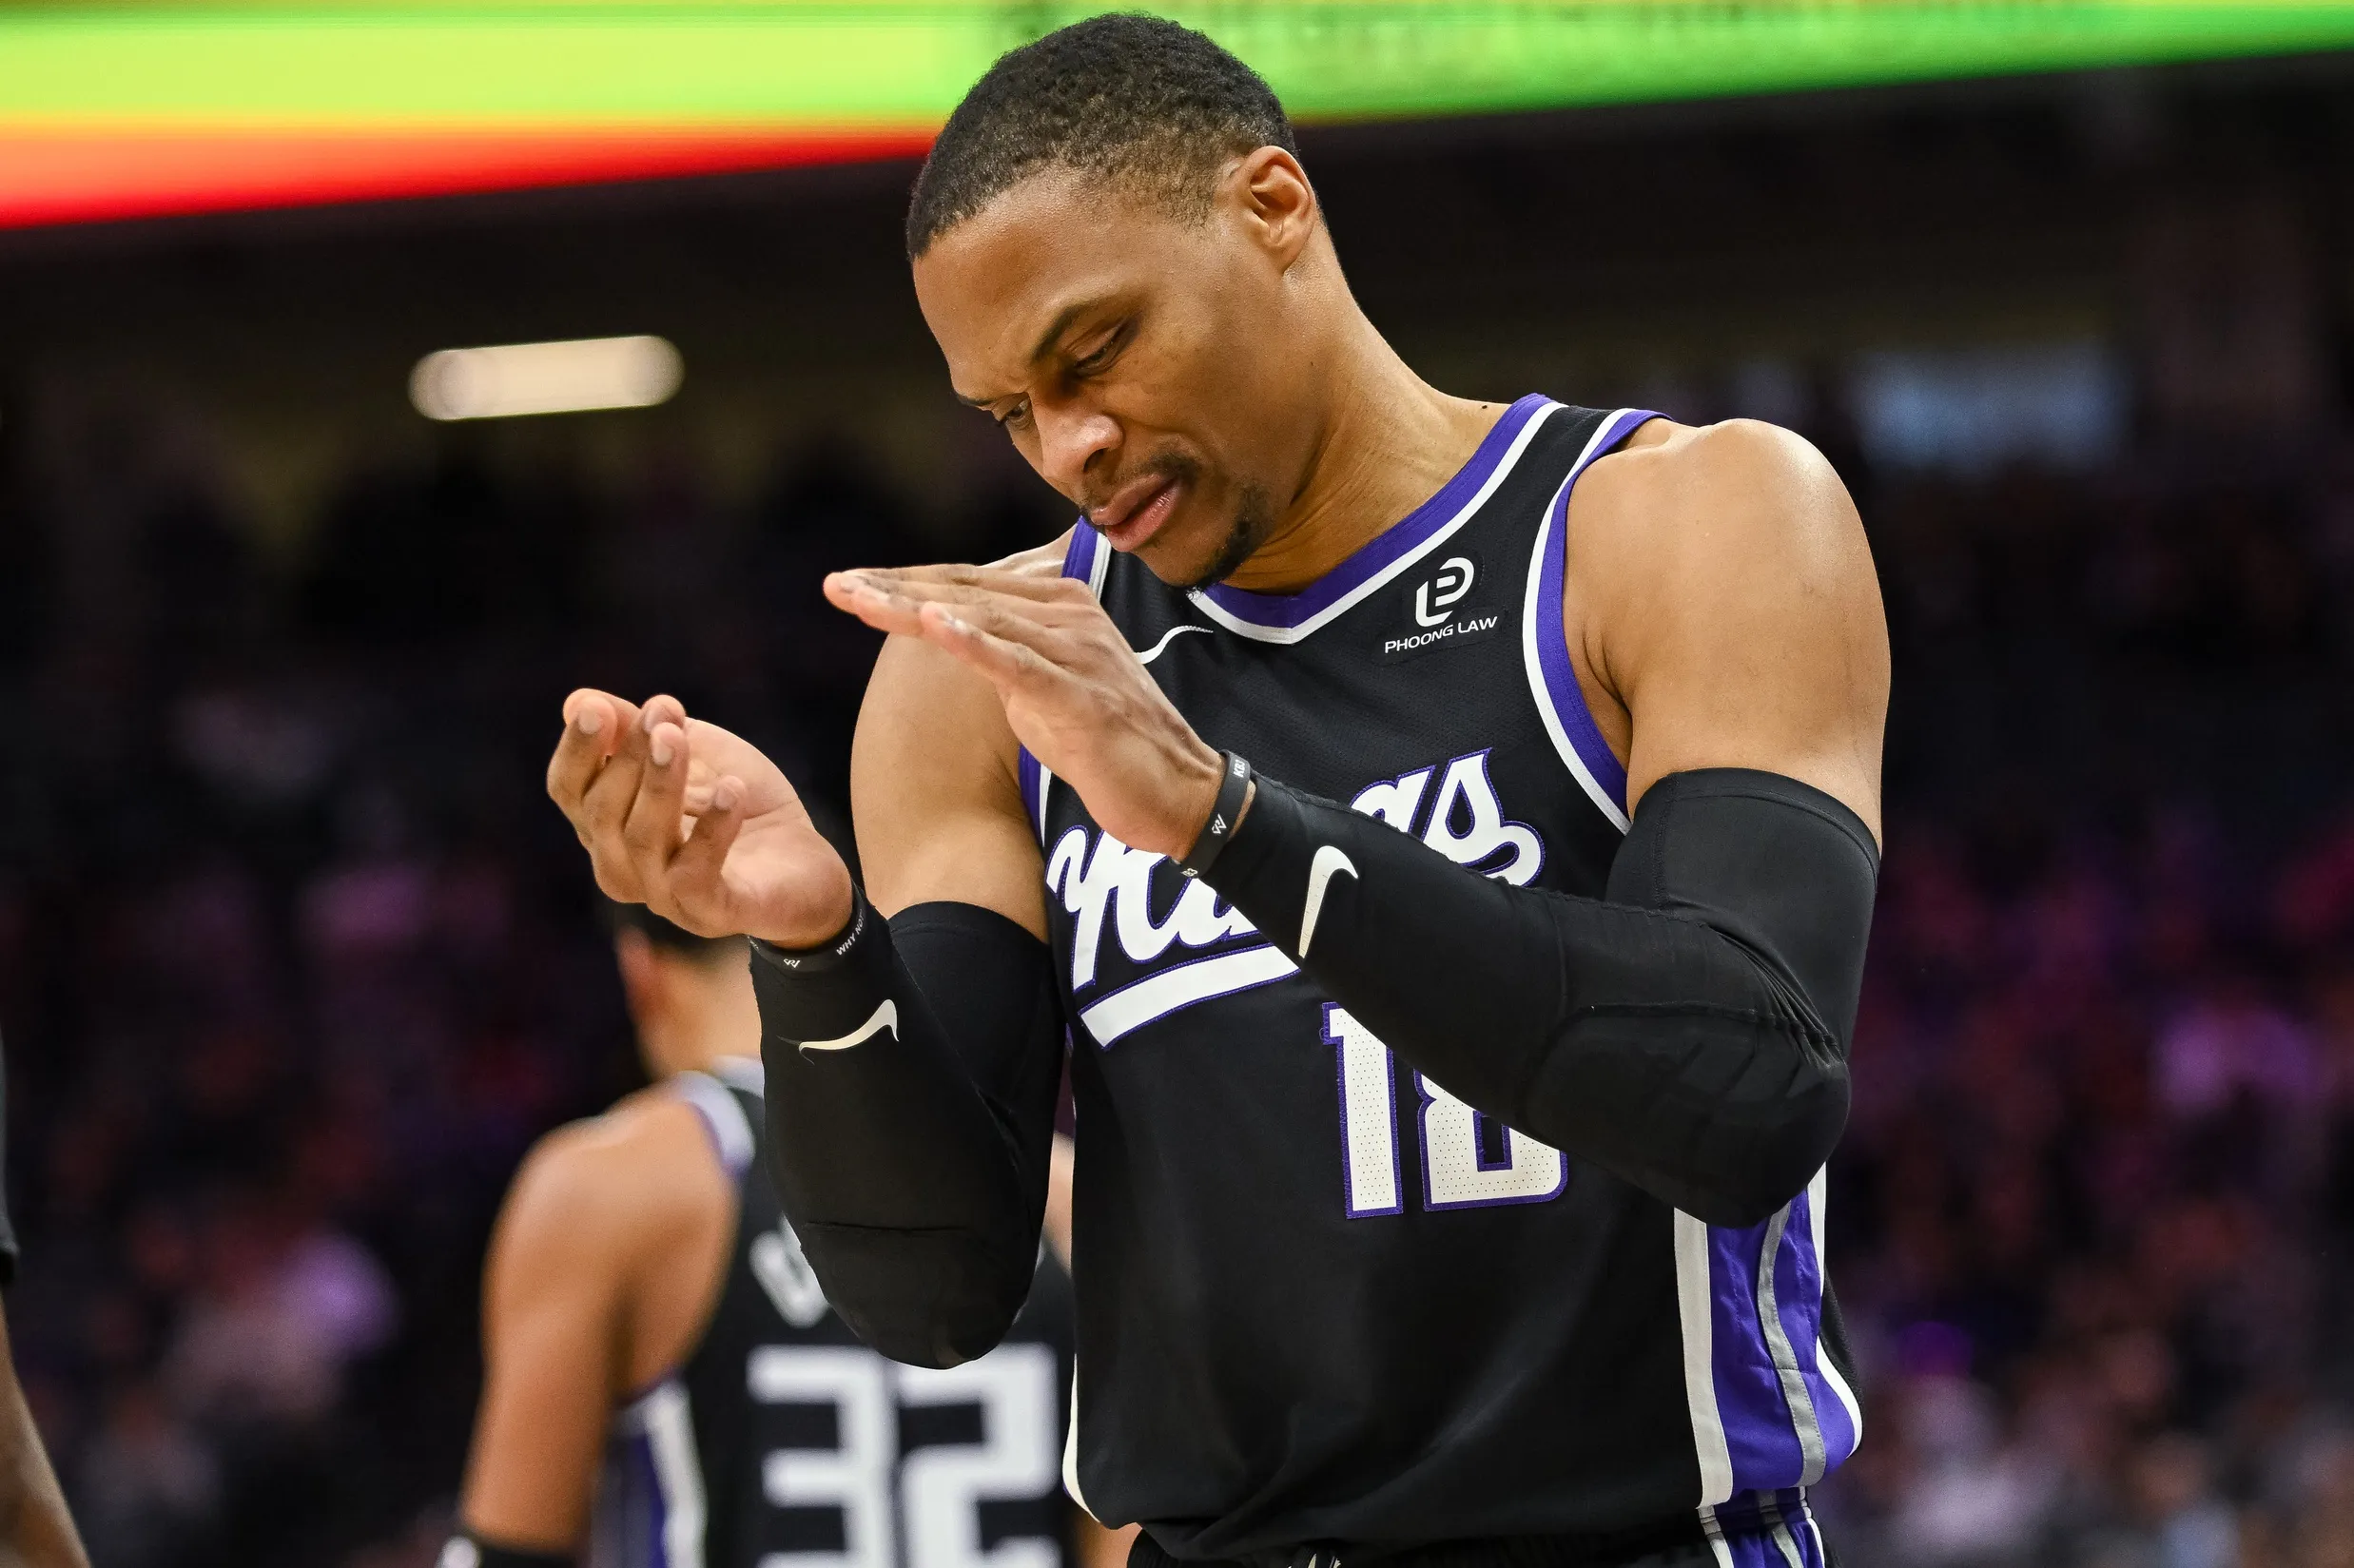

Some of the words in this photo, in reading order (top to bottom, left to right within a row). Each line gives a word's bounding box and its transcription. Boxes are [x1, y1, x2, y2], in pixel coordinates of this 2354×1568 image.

[1384, 624, 1454, 654] PHOONG
[1457, 615, 1498, 634] LAW
[836, 933, 857, 956] WHY
[747, 1342, 1060, 1568] 32
